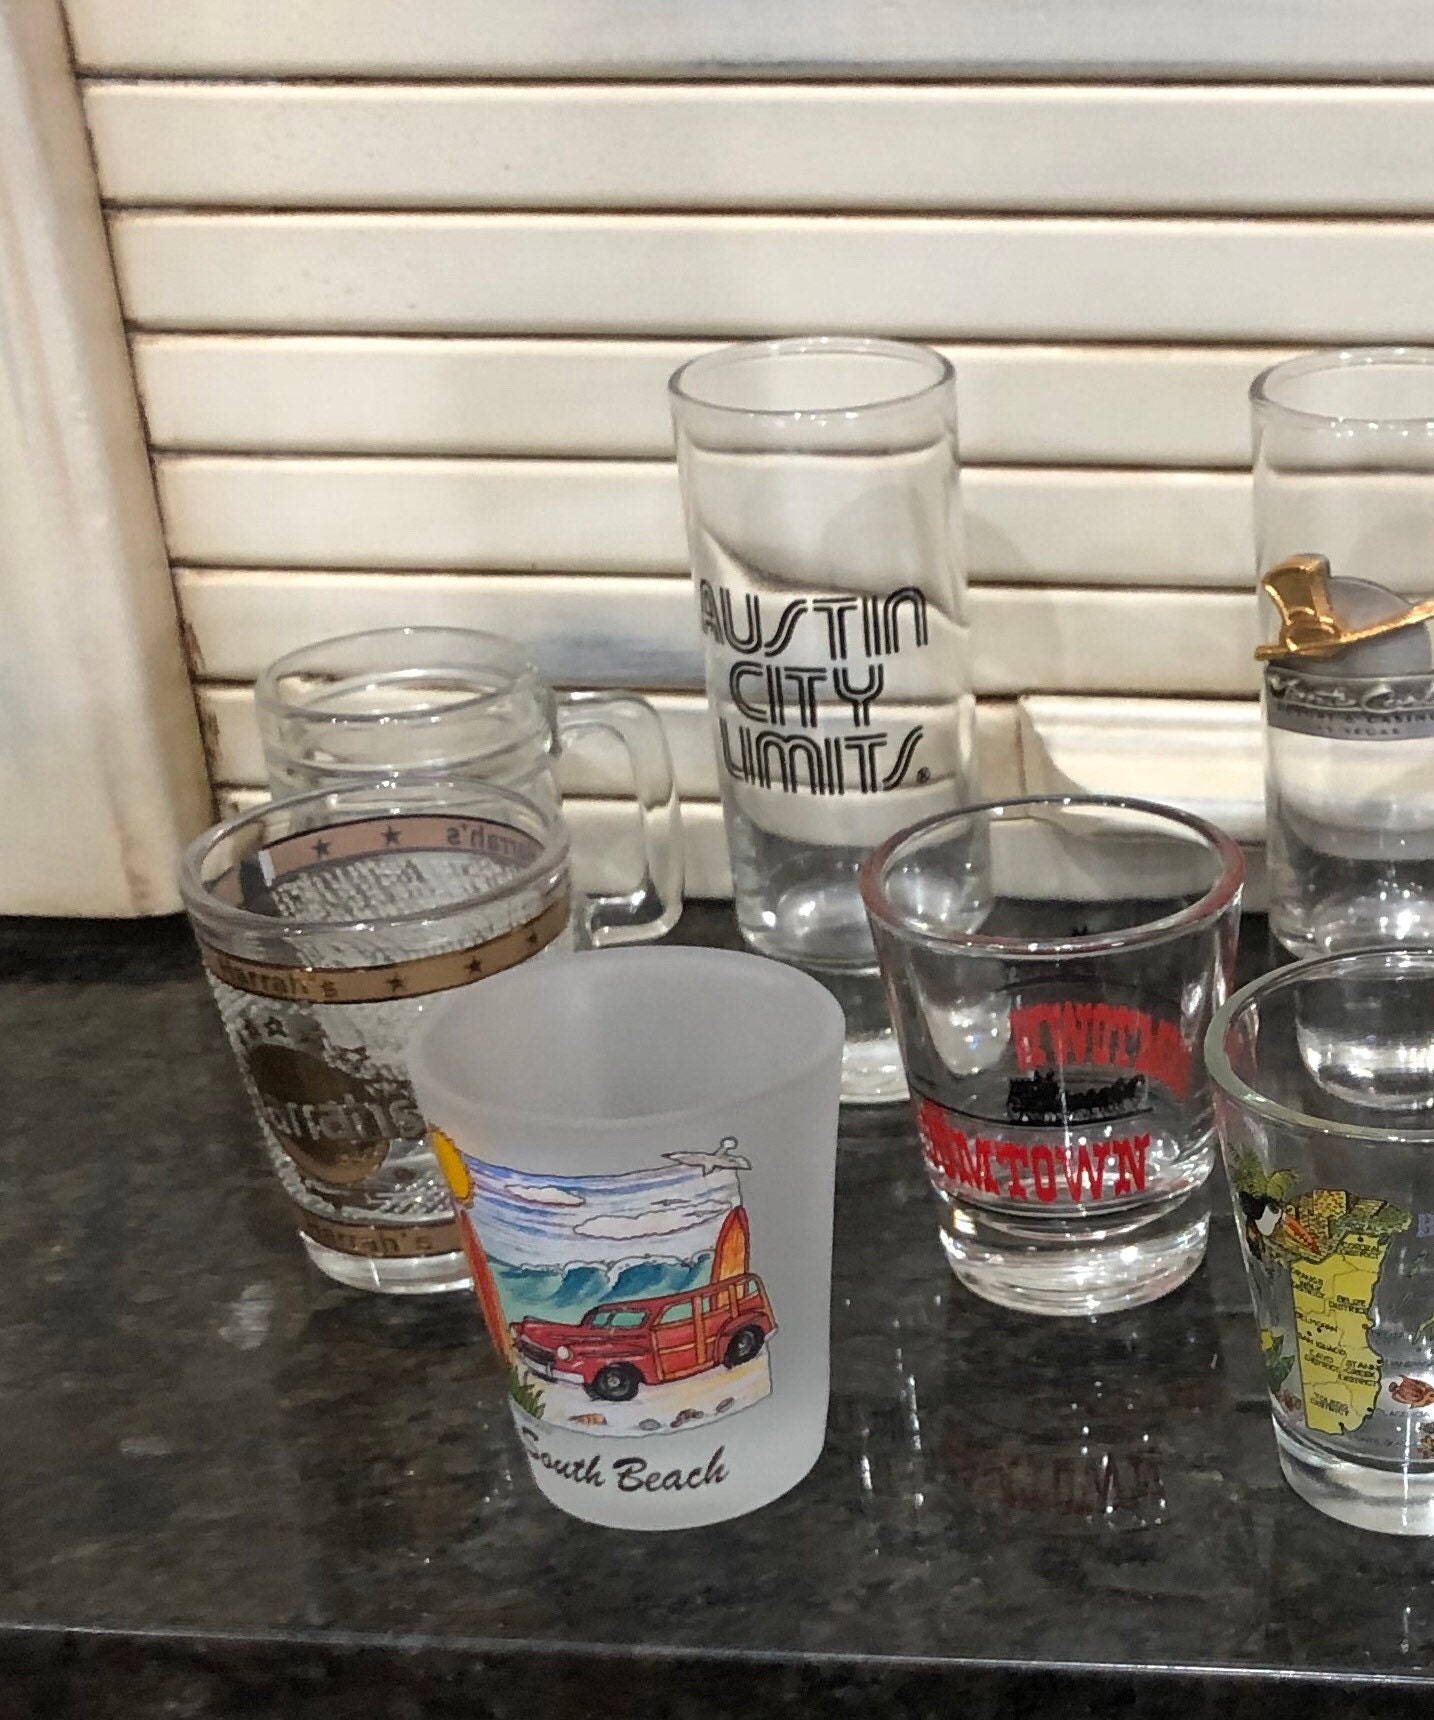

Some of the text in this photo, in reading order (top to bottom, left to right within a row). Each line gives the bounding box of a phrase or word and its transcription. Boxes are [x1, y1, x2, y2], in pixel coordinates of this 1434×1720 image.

[700, 578, 928, 660] AUSTIN
[729, 660, 884, 728] CITY
[519, 1426, 729, 1492] South Beach
